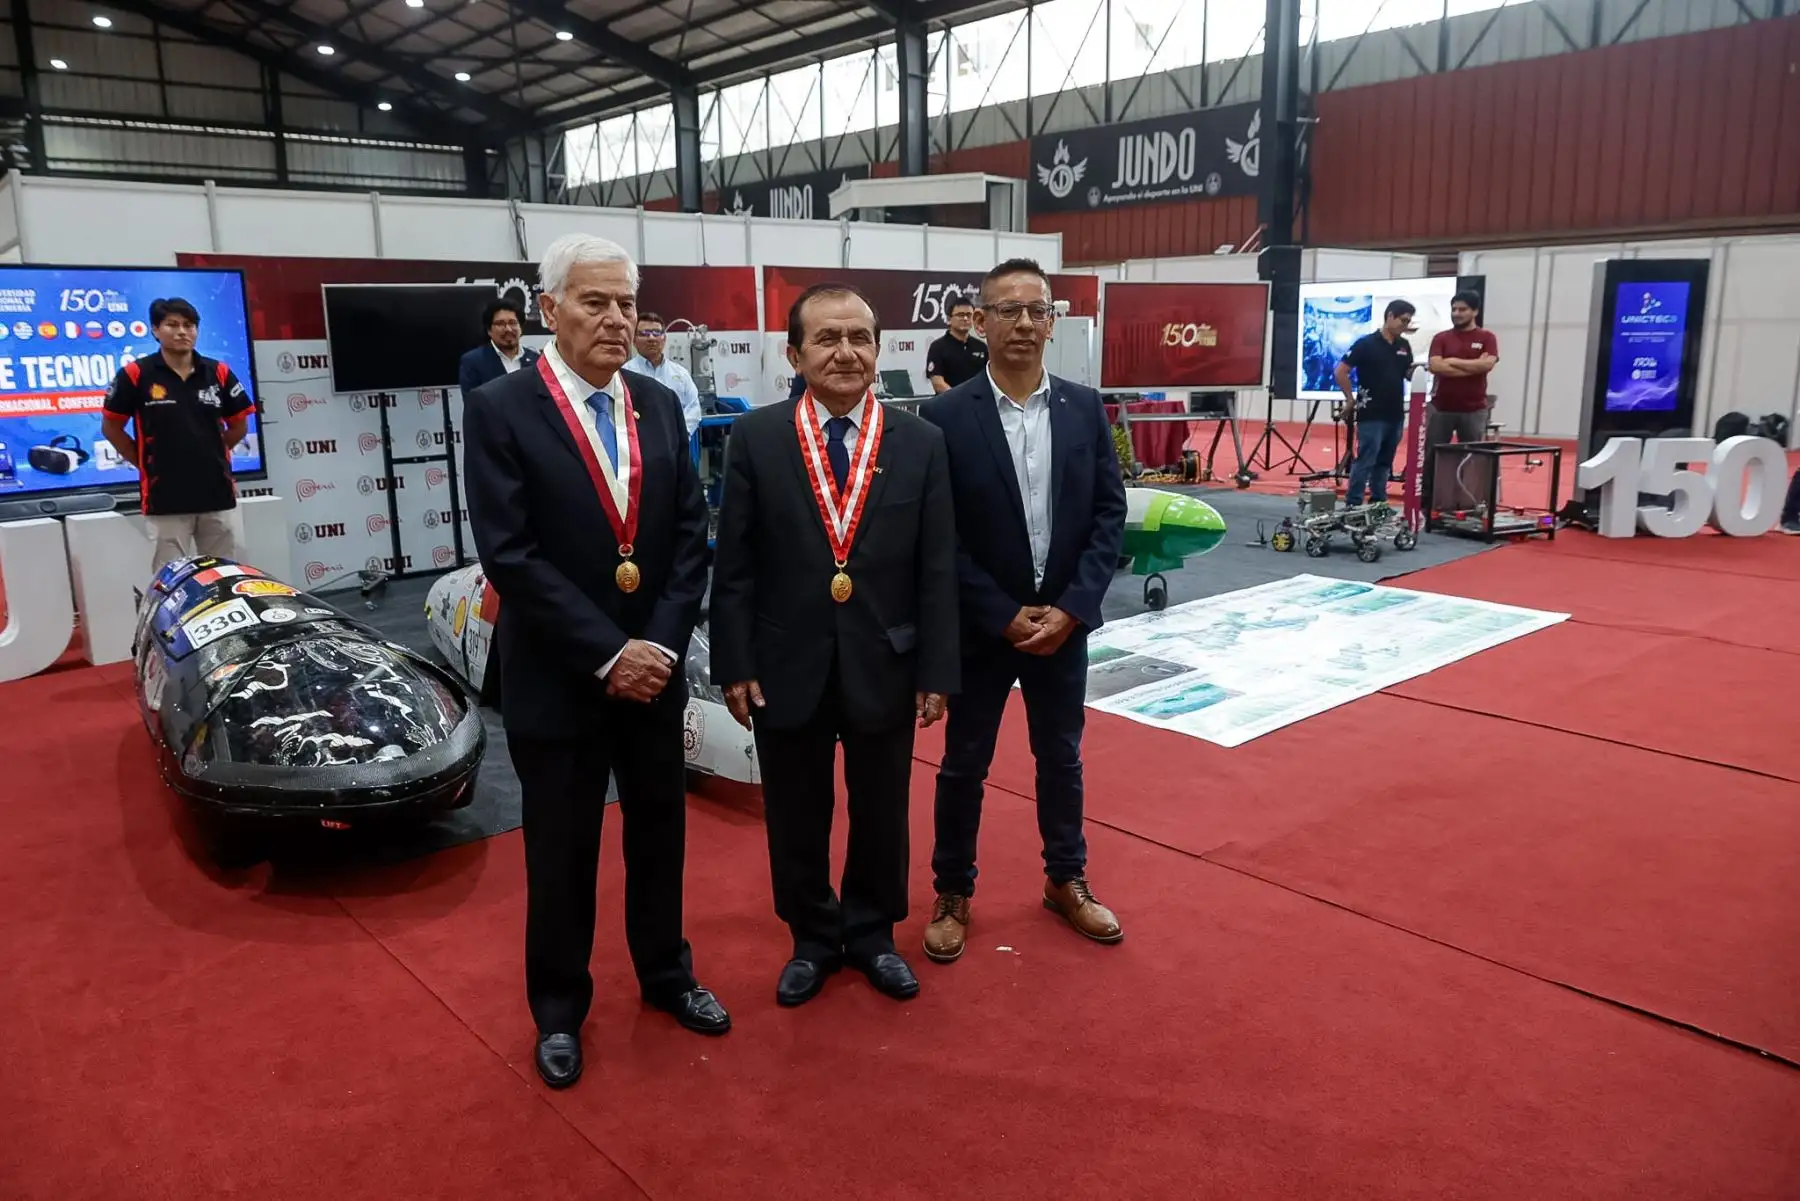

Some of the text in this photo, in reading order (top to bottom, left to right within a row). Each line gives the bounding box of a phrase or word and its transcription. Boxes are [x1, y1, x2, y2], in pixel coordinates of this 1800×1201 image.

[1112, 127, 1196, 189] JUNDO
[60, 289, 104, 312] 150
[1160, 323, 1198, 347] 150
[730, 342, 751, 354] UNI
[899, 341, 915, 351] UNI
[296, 354, 329, 369] UNI
[433, 430, 461, 444] UI
[306, 440, 337, 454] UNI
[1578, 435, 1788, 538] 150
[441, 509, 468, 523] UI
[314, 523, 346, 538] UNI
[194, 610, 247, 640] 330
